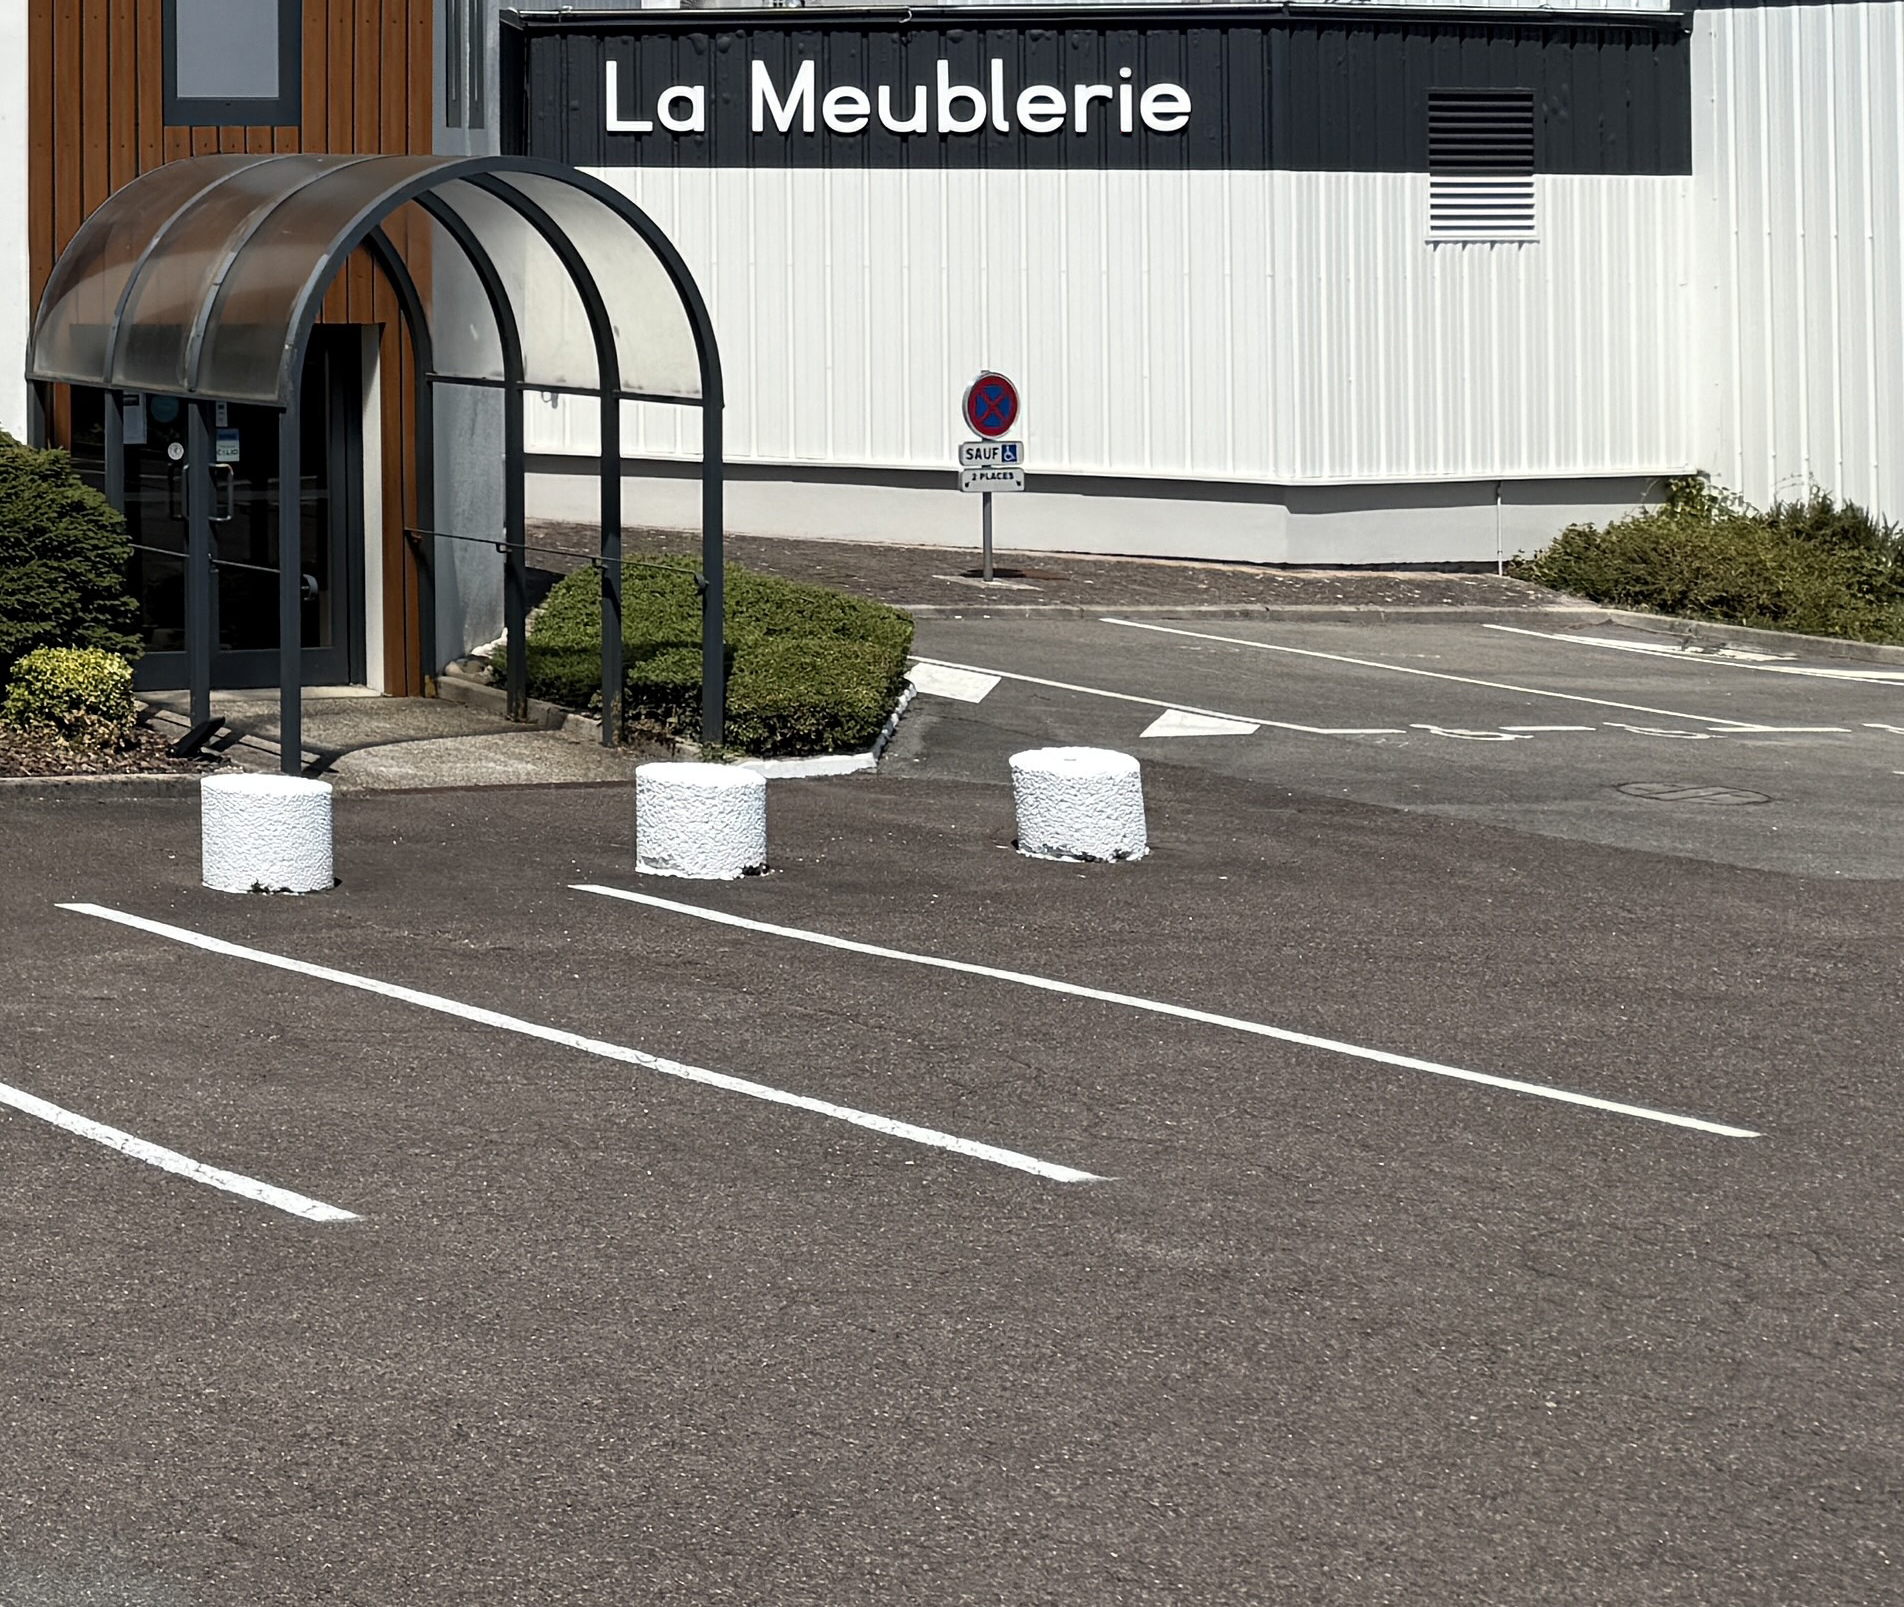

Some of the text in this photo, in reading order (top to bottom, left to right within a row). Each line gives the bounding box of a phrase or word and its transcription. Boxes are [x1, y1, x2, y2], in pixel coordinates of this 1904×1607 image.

[605, 58, 1192, 133] La Meublerie
[966, 447, 999, 460] SAUF
[980, 472, 1014, 481] PLACES
